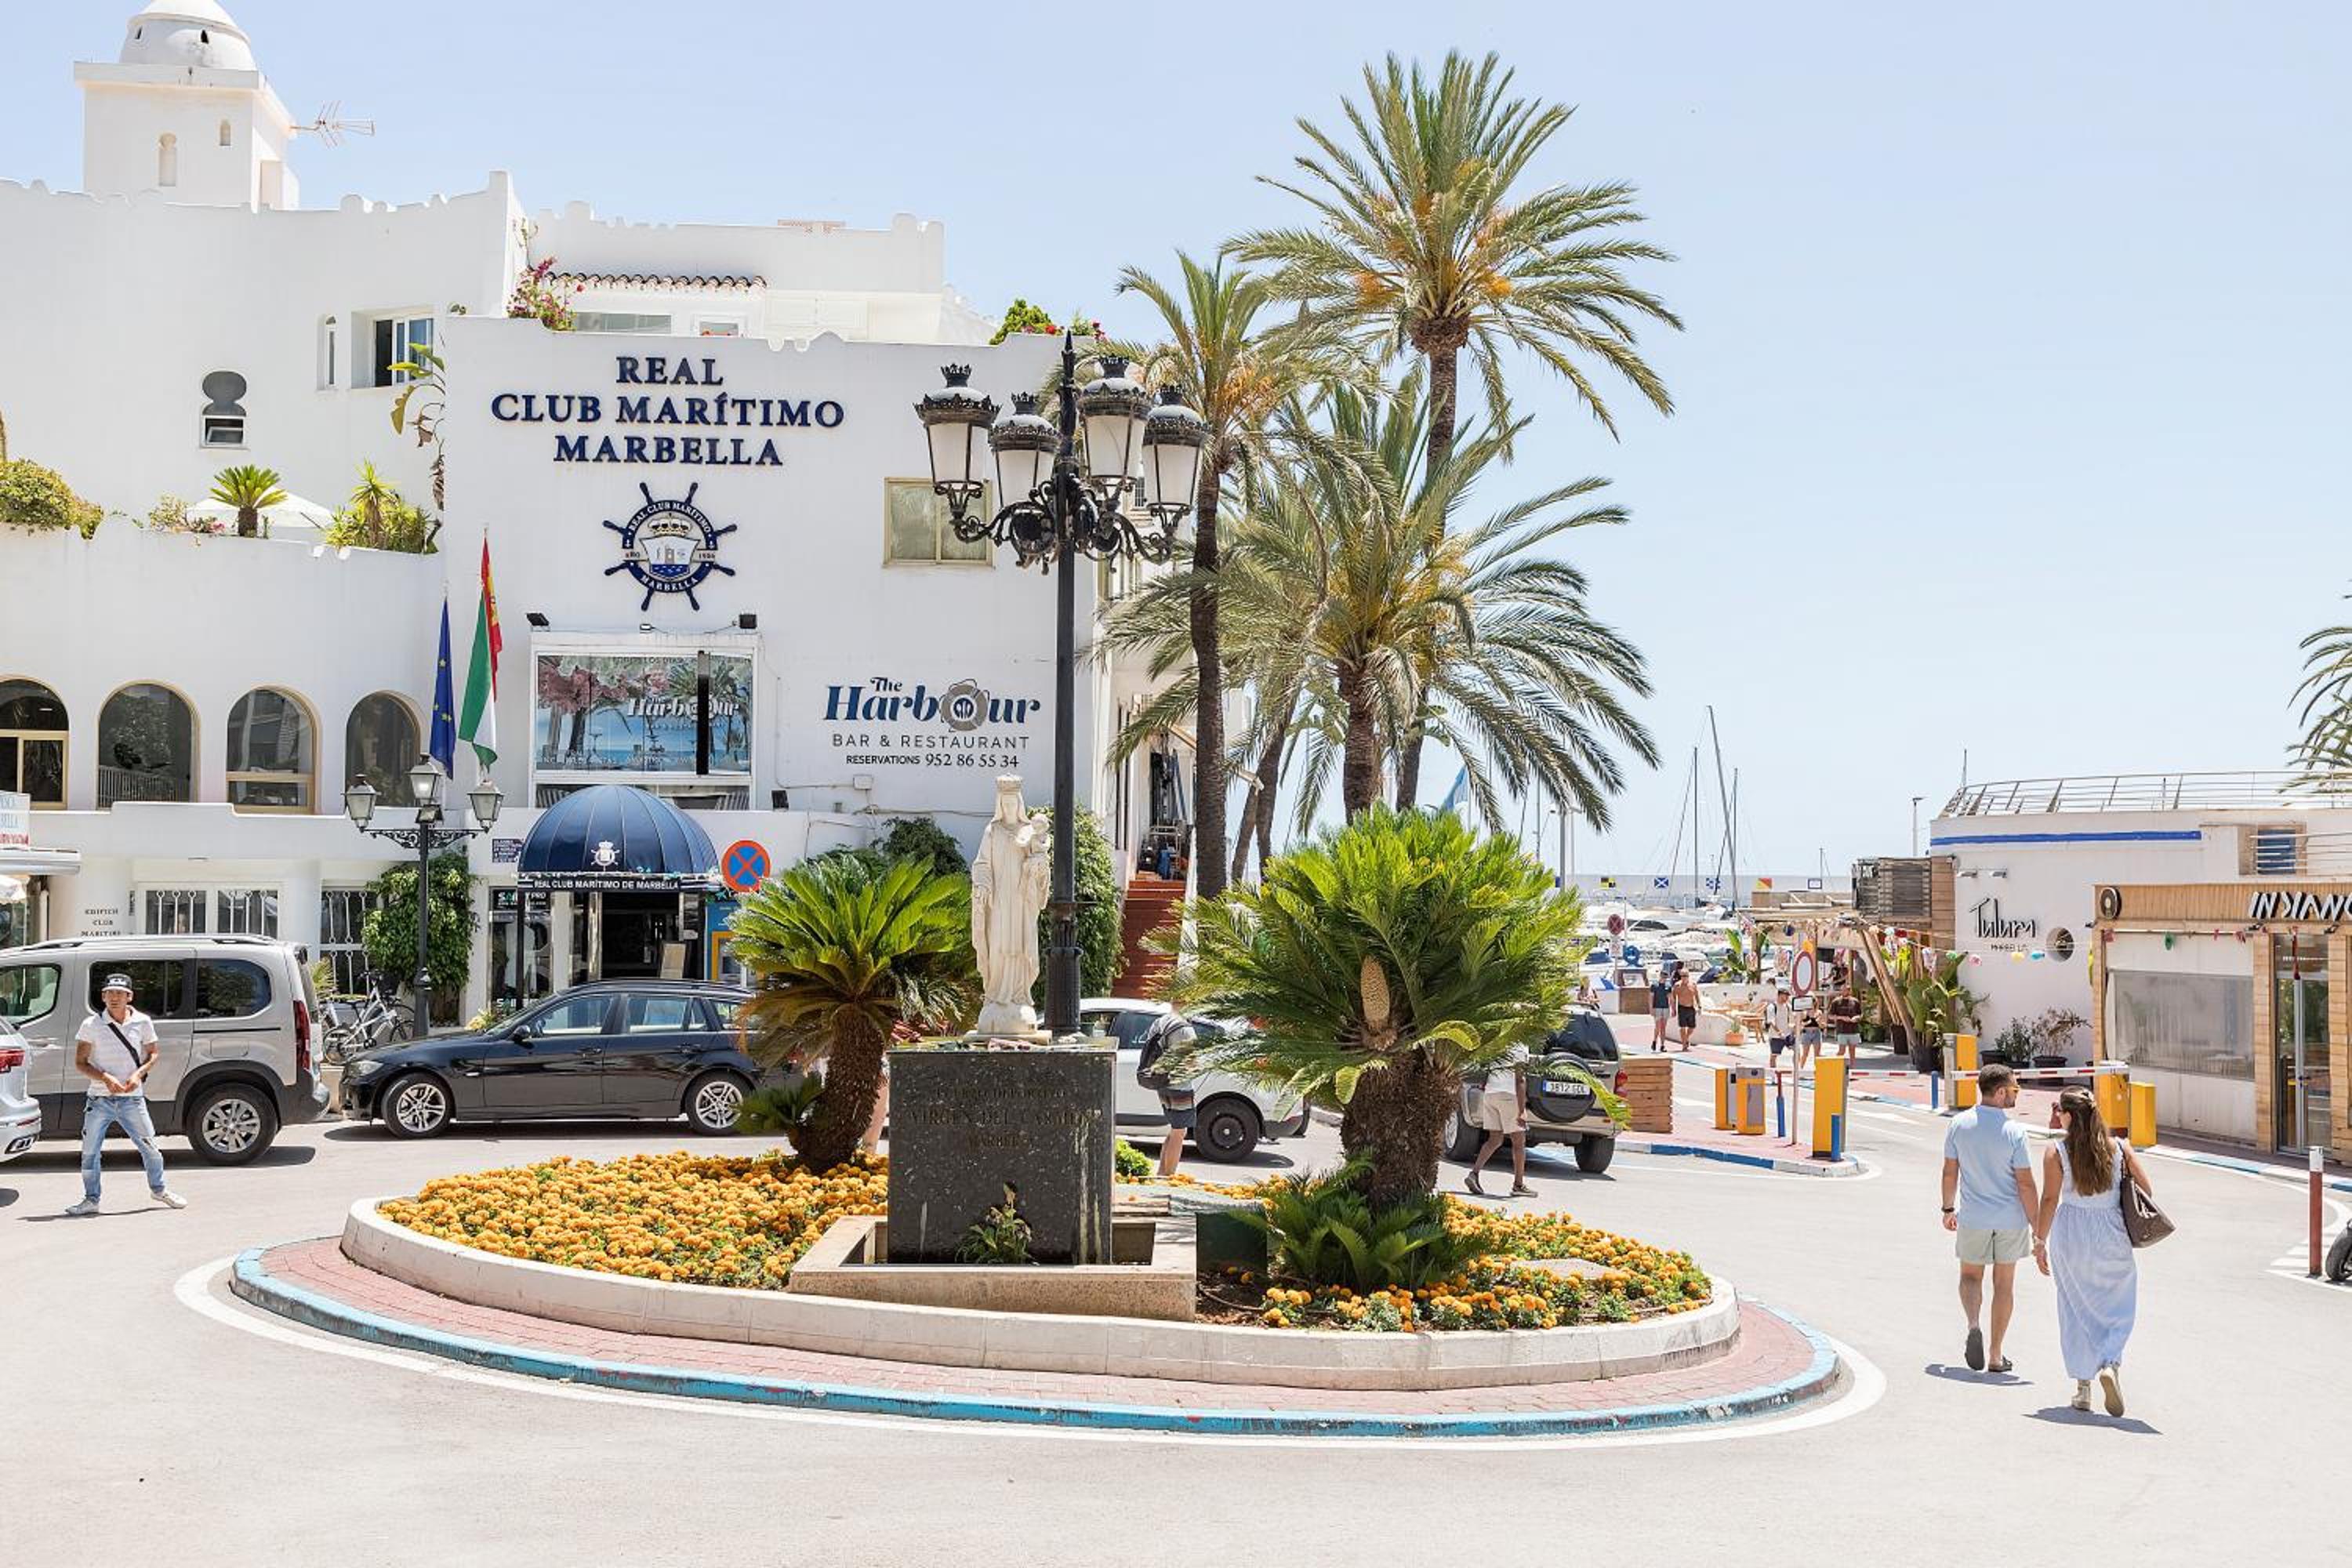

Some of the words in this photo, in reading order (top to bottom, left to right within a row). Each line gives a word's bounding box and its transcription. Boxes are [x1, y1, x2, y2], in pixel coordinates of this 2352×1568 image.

[616, 358, 724, 386] REAL
[492, 394, 601, 422] CLUB
[616, 392, 844, 428] MARÍTIMO
[554, 435, 783, 466] MARBELLA
[647, 502, 670, 514] CLUB
[641, 575, 698, 590] MARBELLA
[870, 677, 902, 692] The
[833, 734, 869, 746] BAR
[880, 735, 890, 746] &
[902, 735, 1029, 749] RESTAURANT
[846, 755, 920, 764] RESERVATIONS
[925, 753, 952, 766] 952
[956, 753, 974, 767] 86
[978, 754, 996, 767] 55
[1000, 755, 1019, 768] 34
[534, 880, 551, 888] REAL
[622, 880, 633, 889] DE
[637, 880, 679, 890] MARBELLA
